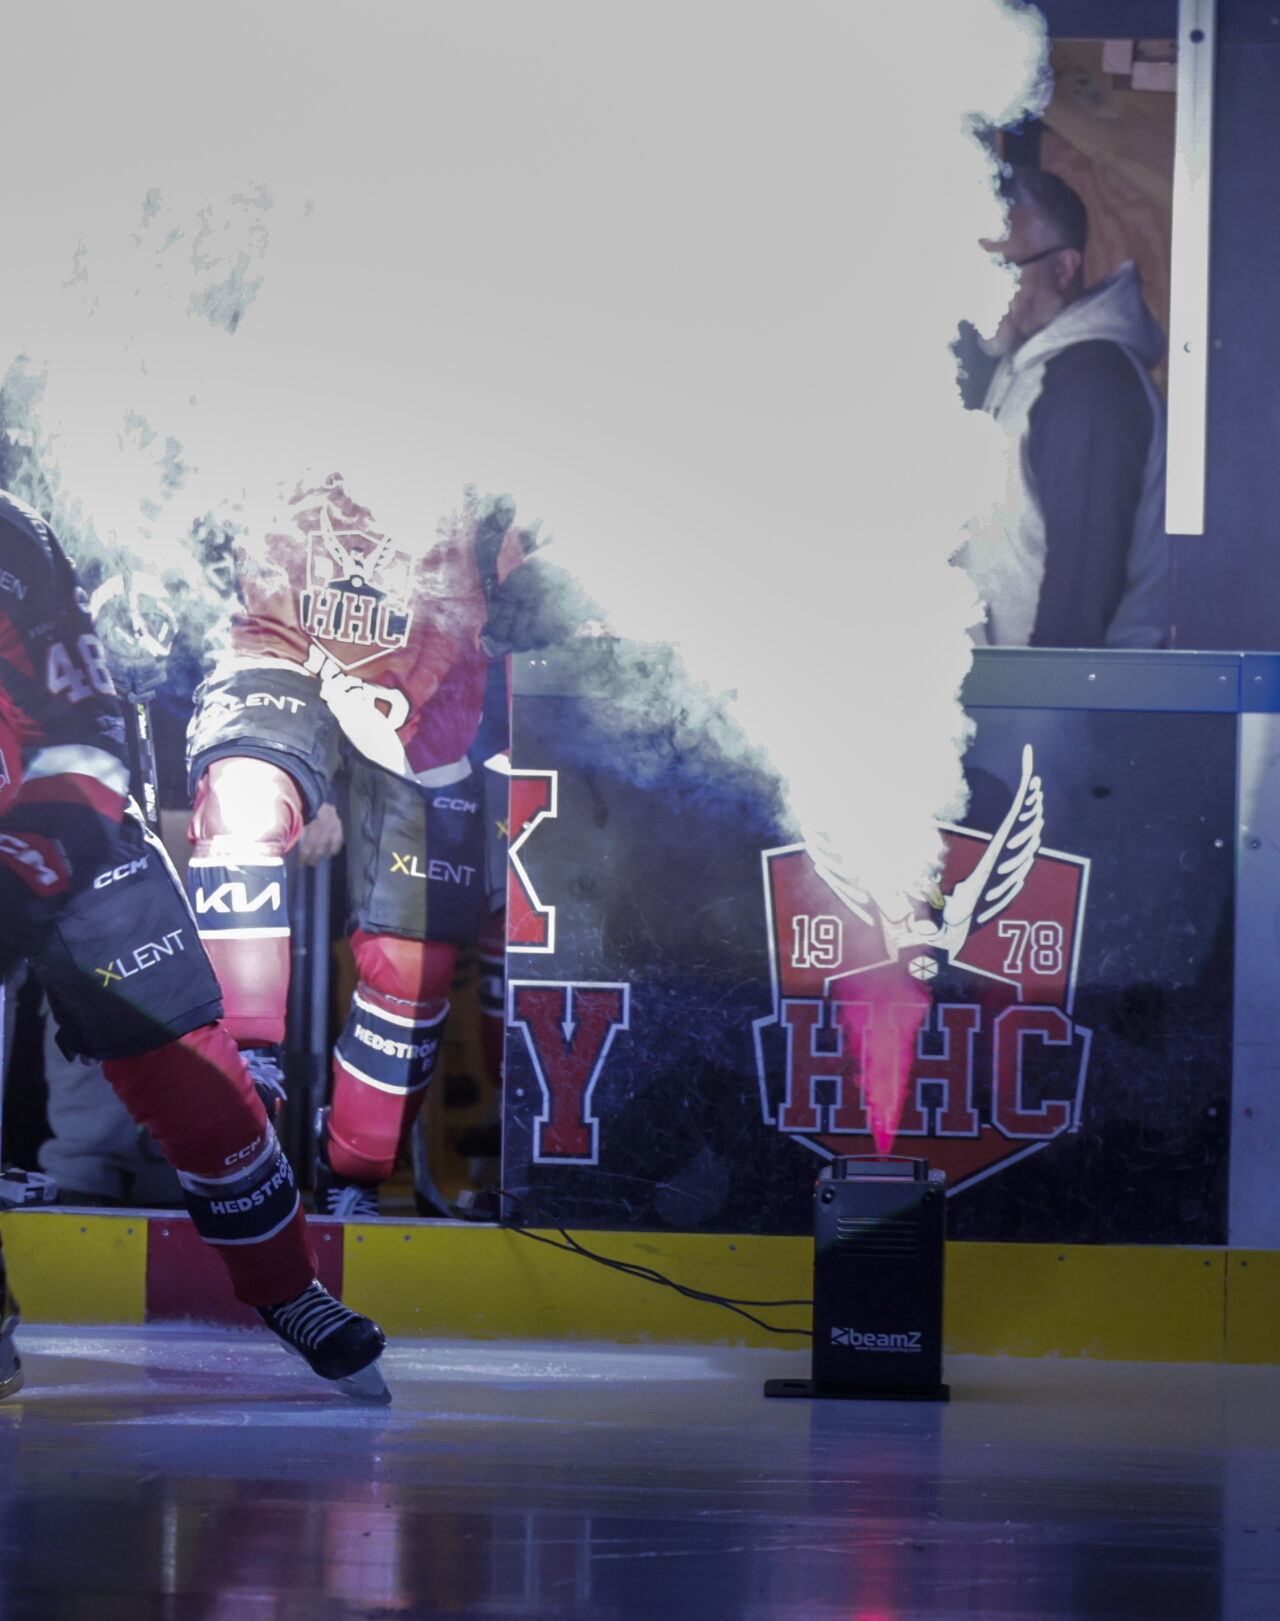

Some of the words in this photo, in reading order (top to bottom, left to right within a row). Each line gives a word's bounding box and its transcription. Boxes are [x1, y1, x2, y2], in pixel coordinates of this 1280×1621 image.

[304, 587, 409, 648] HHC
[47, 633, 117, 703] 48
[228, 692, 307, 714] LENT
[433, 796, 477, 814] CCM
[93, 854, 150, 890] CCM
[389, 851, 477, 887] XLENT
[94, 928, 186, 988] XLENT
[790, 914, 843, 969] 19
[997, 919, 1064, 975] 78
[777, 997, 1073, 1140] HHC
